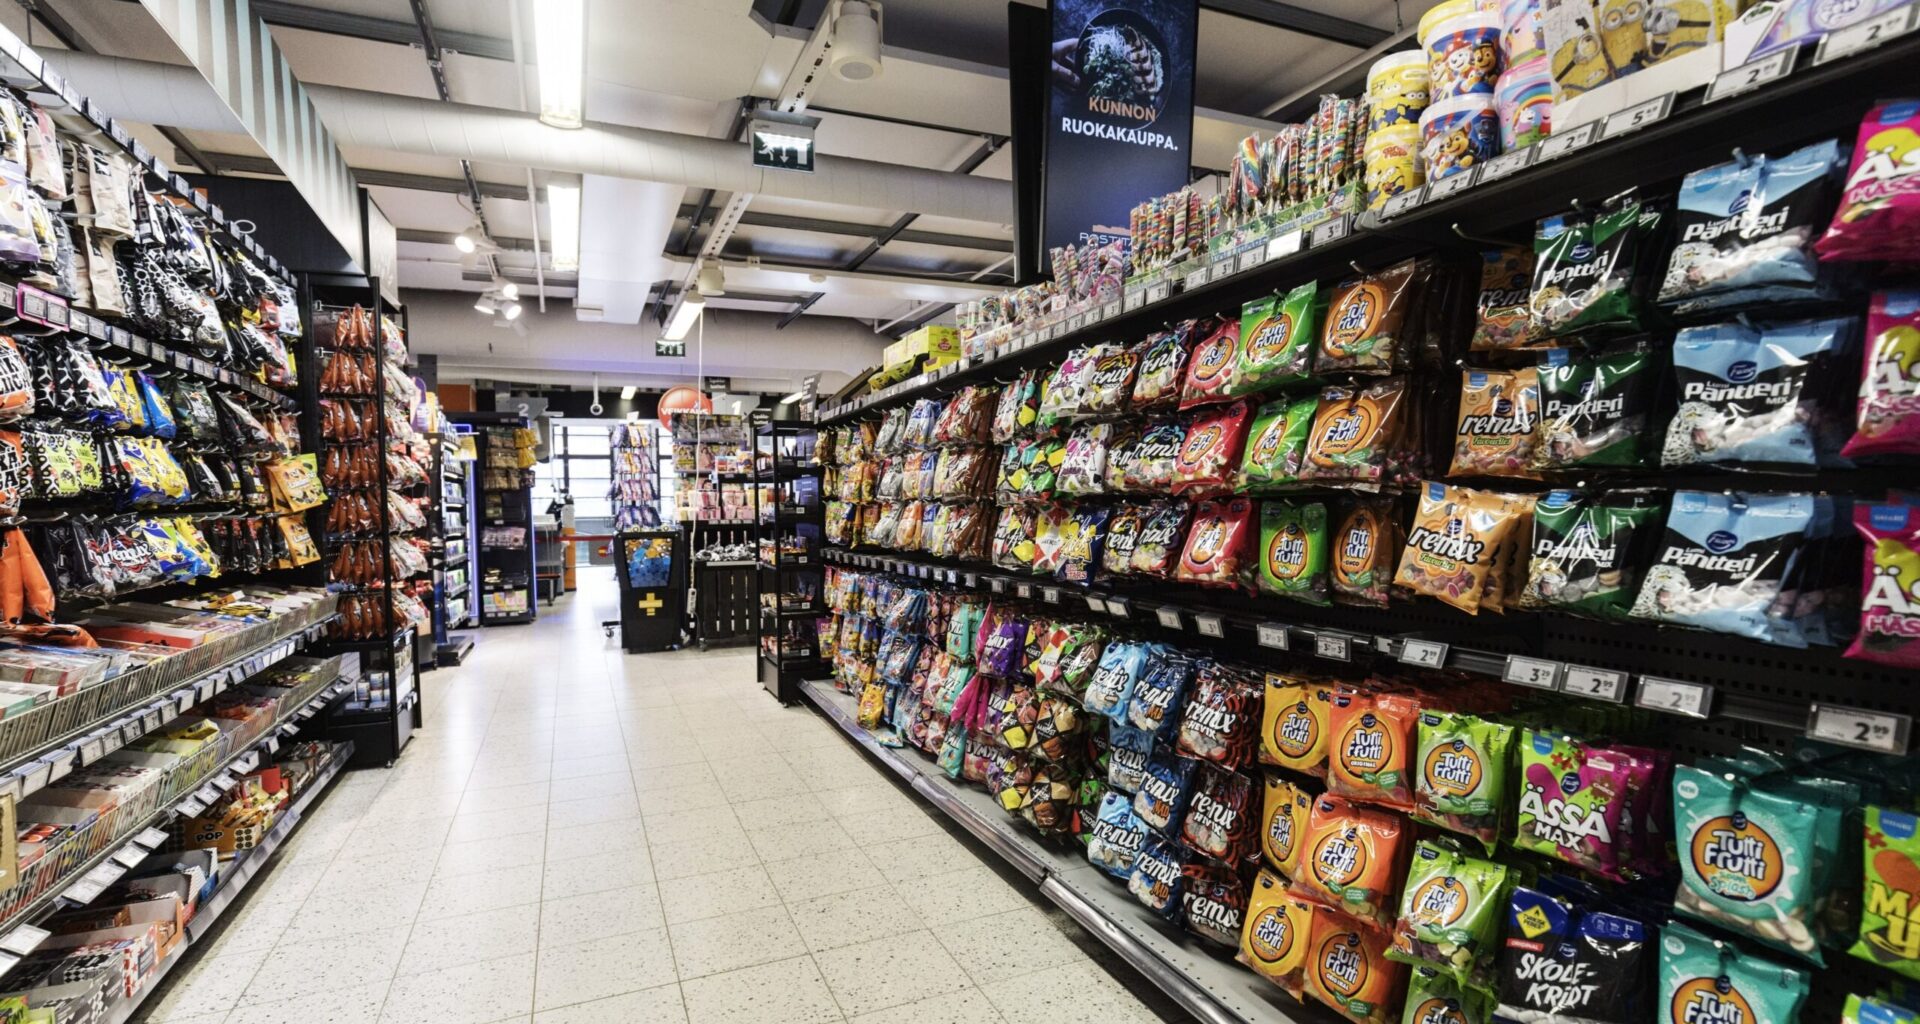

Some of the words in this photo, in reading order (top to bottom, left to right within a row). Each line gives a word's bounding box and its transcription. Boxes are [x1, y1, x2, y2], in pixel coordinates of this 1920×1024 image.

[1089, 96, 1156, 122] KUNNON
[1062, 117, 1178, 151] RUOKAKAUPPA.
[1685, 378, 1792, 402] Pantteri
[1766, 397, 1789, 406] MIX
[517, 404, 530, 417] 2
[732, 401, 742, 416] 1
[1606, 411, 1622, 419] MIX
[1662, 546, 1758, 573] Pantteri
[1185, 700, 1236, 733] remix
[1434, 761, 1472, 785] Frutti
[1440, 751, 1473, 772] Tutti
[1519, 783, 1612, 844] ÄSSÄ
[1534, 822, 1584, 852] MAX
[1712, 829, 1765, 860] Tutti
[1704, 841, 1767, 881] Frutti
[1708, 875, 1757, 900] Splash
[1325, 952, 1359, 985] Frutti
[1515, 953, 1600, 984] SKOLE-
[1695, 990, 1744, 1023] Tutti
